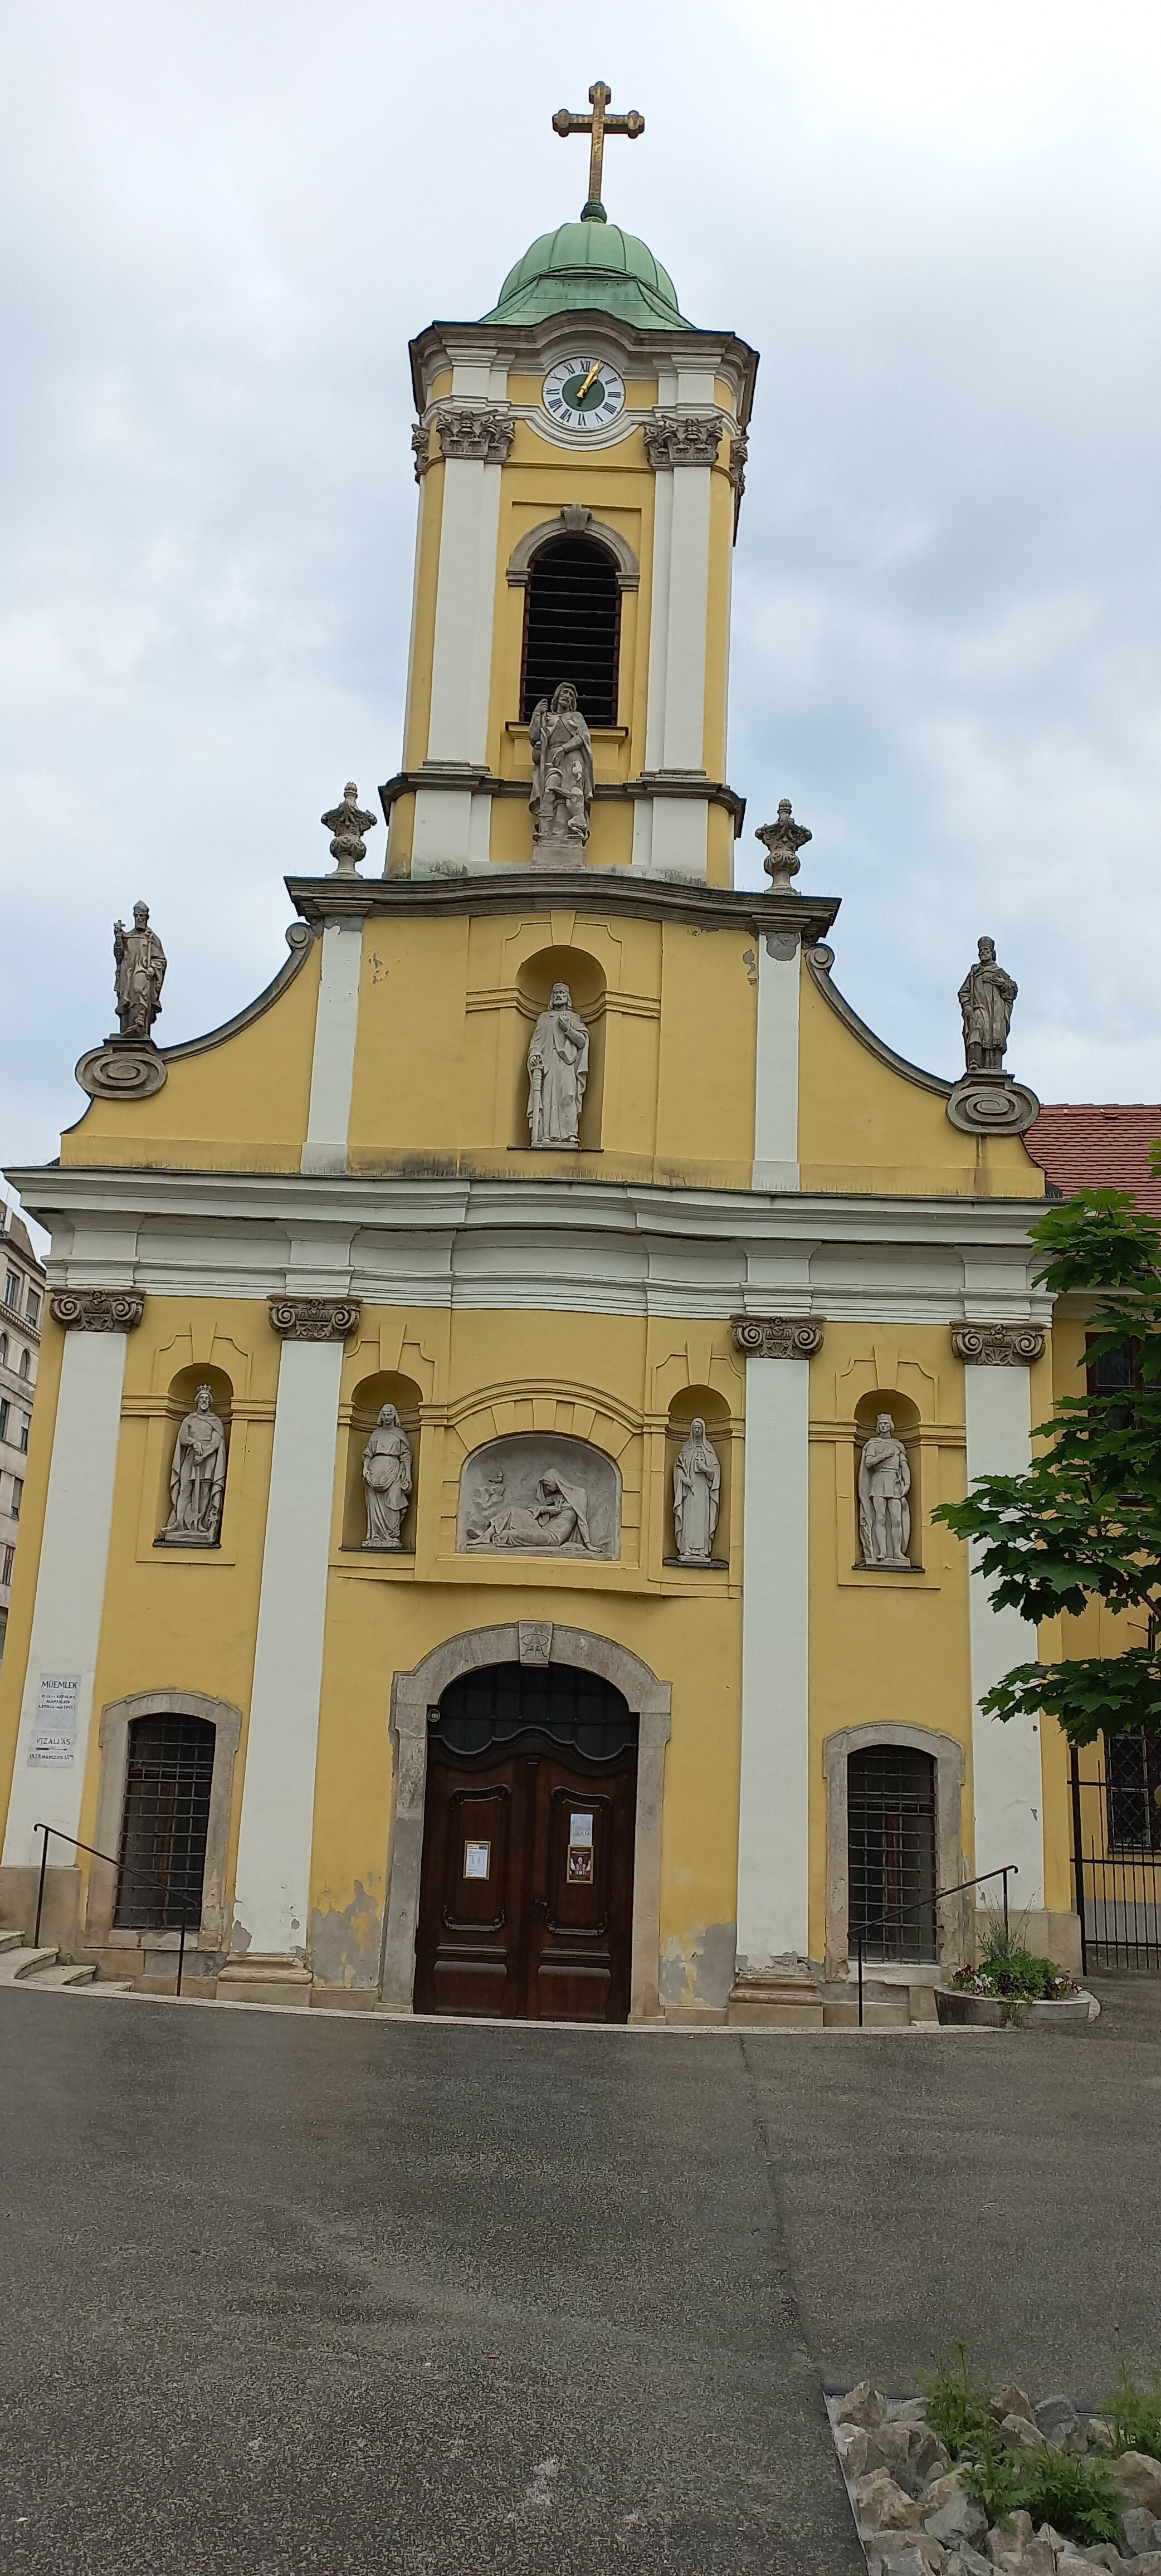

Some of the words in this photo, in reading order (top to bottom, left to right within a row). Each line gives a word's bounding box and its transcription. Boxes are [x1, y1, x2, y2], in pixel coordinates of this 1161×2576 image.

[563, 363, 575, 375] XI
[580, 360, 591, 372] XII
[550, 373, 565, 384] X
[604, 377, 618, 385] II
[548, 398, 563, 413] VIII
[602, 402, 618, 414] IIII
[559, 408, 572, 423] VII
[578, 413, 586, 426] VI
[594, 412, 603, 423] V
